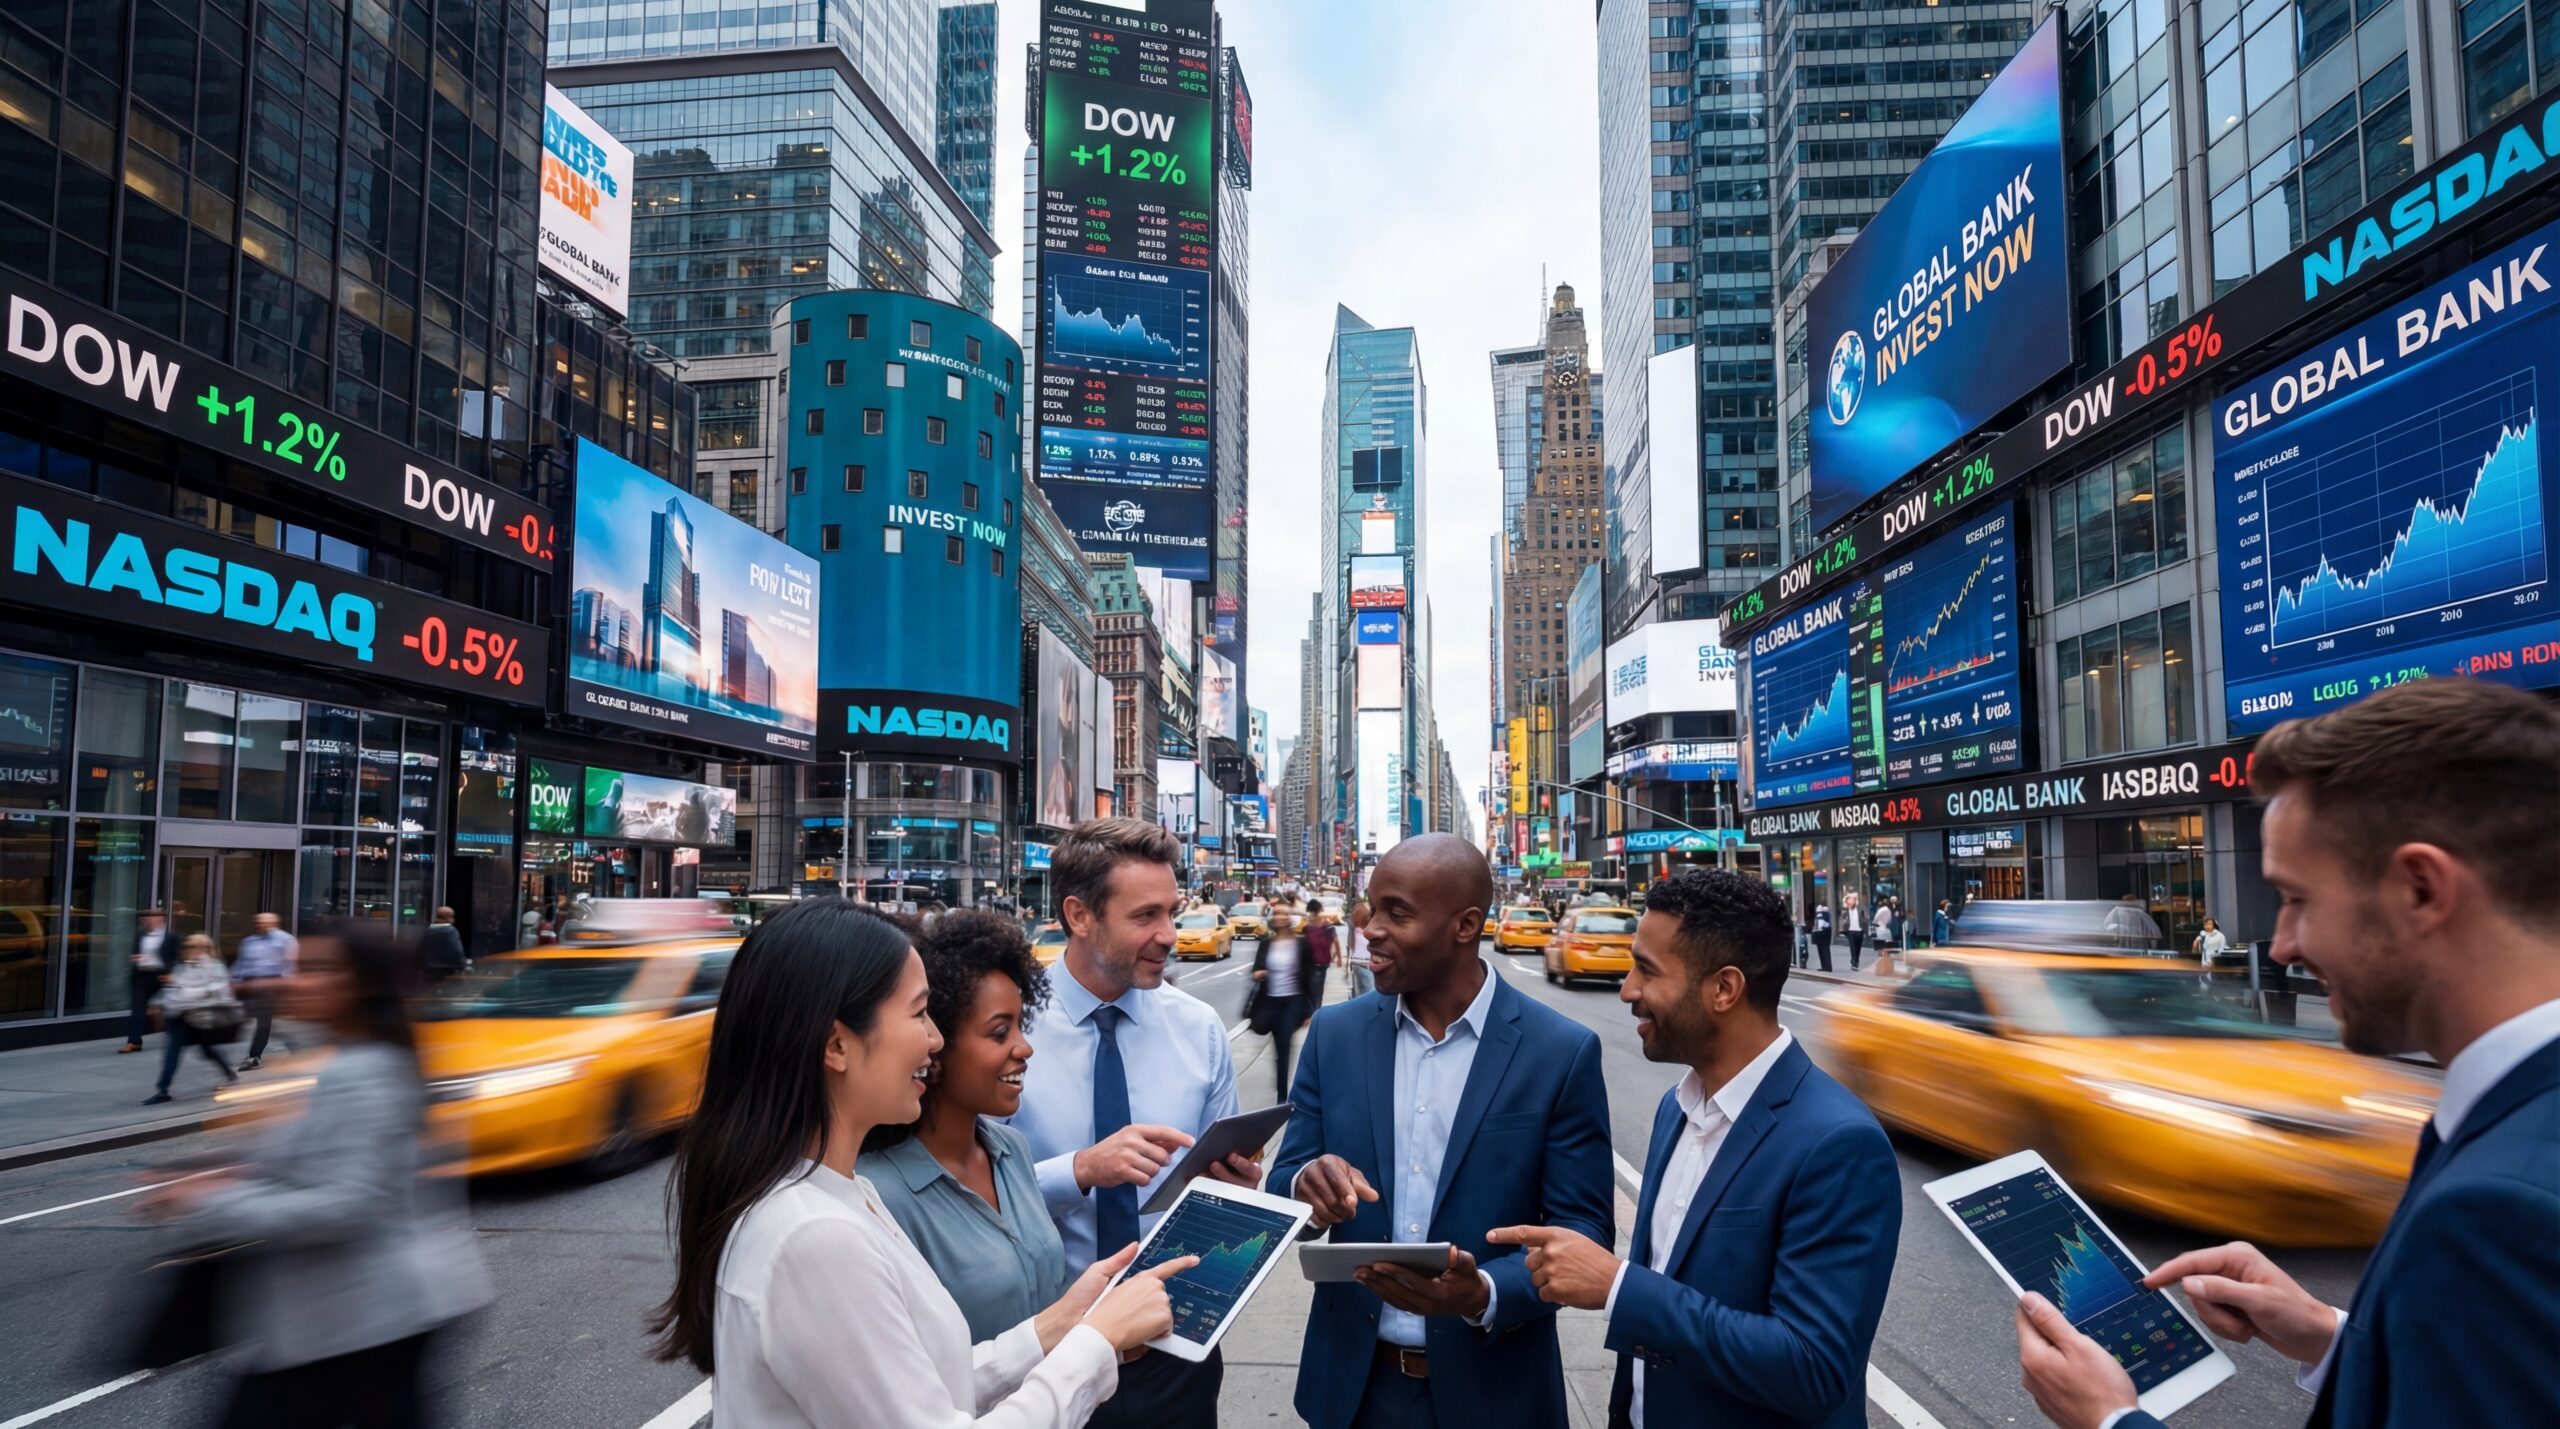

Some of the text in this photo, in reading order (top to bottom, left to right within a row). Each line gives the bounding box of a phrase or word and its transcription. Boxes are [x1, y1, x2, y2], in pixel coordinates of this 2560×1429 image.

[1084, 102, 1175, 142] DOW
[1070, 143, 1187, 185] +1.2%
[547, 231, 590, 268] GLOBAL
[1873, 162, 2035, 342] GLOBAL BANK
[1876, 212, 2035, 387] INVEST NOW
[2224, 242, 2552, 437] GLOBAL BANK
[8, 294, 346, 481] DOW +1.2%
[2045, 313, 2222, 450] DOW -0.5%
[404, 463, 495, 537] DOW
[889, 504, 1007, 548] INVEST NOW
[1883, 492, 1927, 542] DOW
[1932, 453, 1994, 508] +1.2%
[13, 505, 524, 686] NASDAQ -0.5%
[1780, 559, 1812, 600] DOW
[1814, 534, 1857, 576] +1.2%
[1754, 619, 1802, 657] GLOBAL
[1804, 597, 1844, 634] BANK
[847, 705, 1009, 752] NASDAQ
[531, 784, 571, 808] DOW
[1750, 814, 1789, 837] GLOBAL
[1789, 809, 1821, 833] BANK
[1883, 797, 1922, 823] -0.5%
[1947, 786, 2020, 817] GLOBAL
[2026, 776, 2086, 809] BANK
